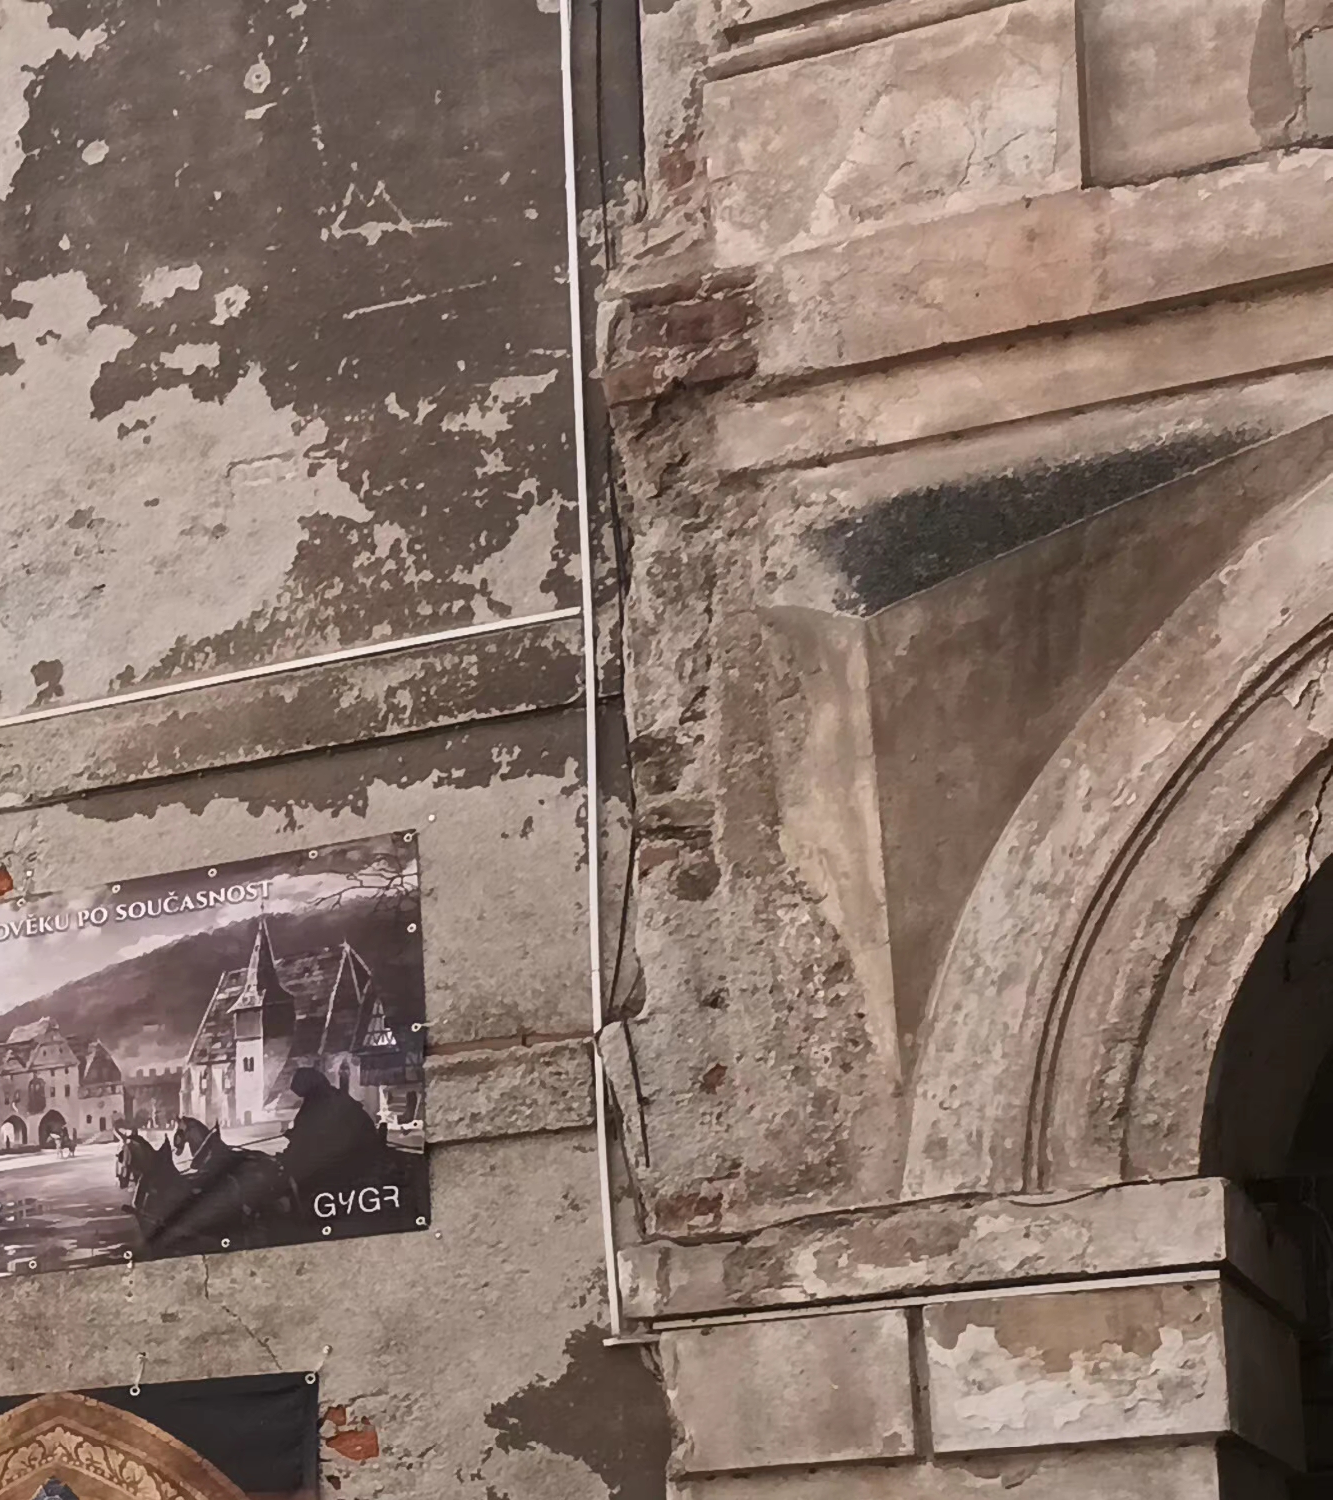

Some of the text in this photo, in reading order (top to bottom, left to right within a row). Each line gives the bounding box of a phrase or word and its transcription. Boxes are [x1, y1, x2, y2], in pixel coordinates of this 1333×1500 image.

[77, 906, 109, 929] PO
[115, 879, 273, 923] SOUČASNOST
[314, 1185, 400, 1218] GYGR
